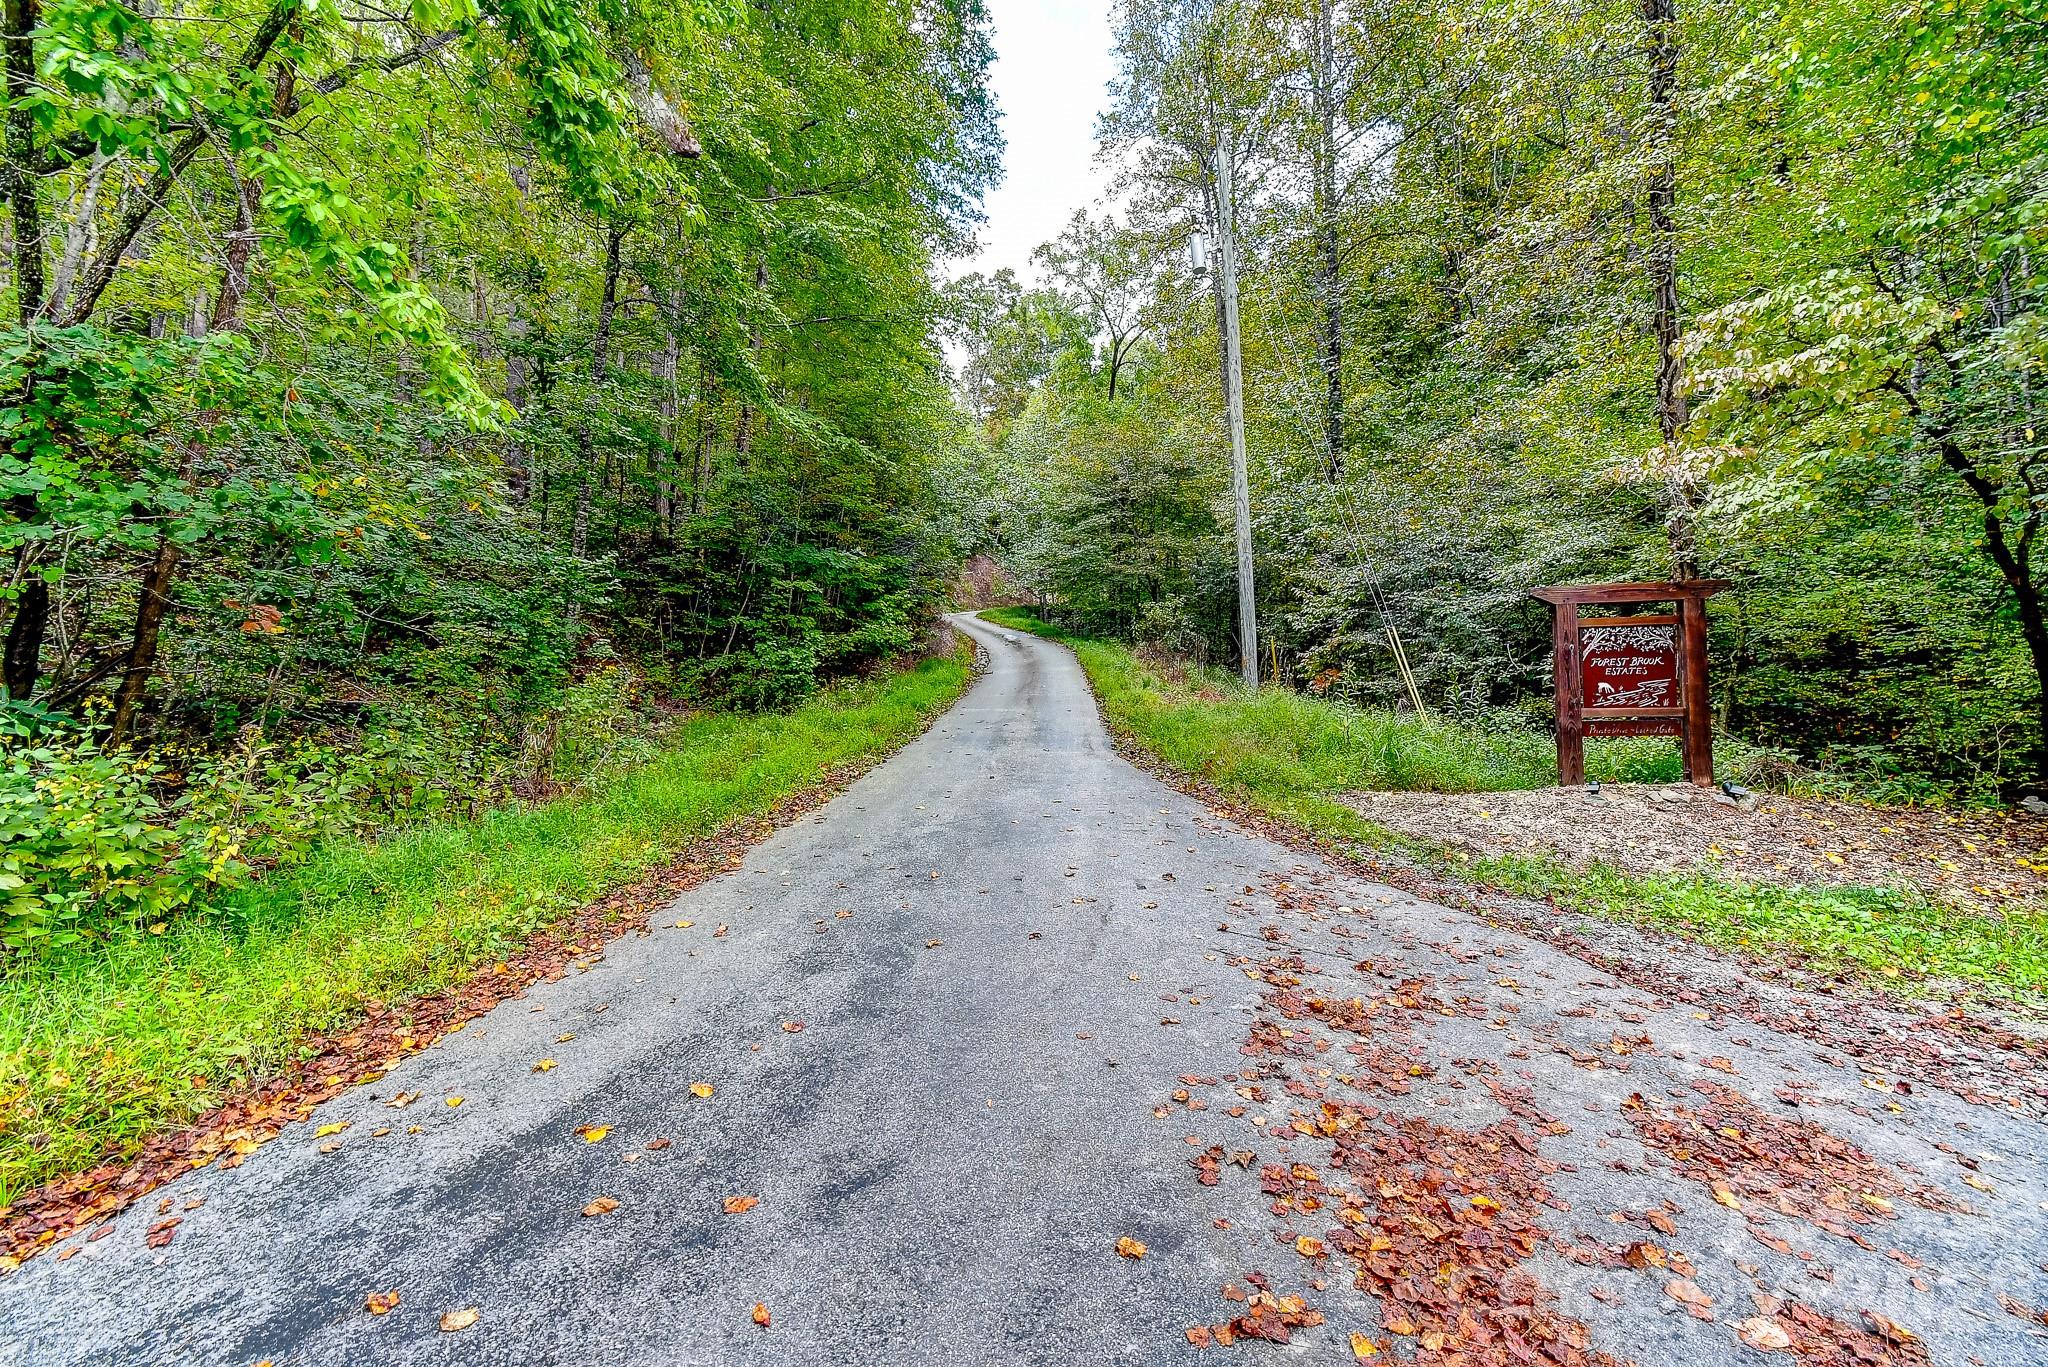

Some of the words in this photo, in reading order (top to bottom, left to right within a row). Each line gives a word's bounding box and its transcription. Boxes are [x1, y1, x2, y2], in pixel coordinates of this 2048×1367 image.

[1590, 657, 1629, 667] FOREST
[1630, 656, 1665, 666] BROOK
[1605, 667, 1648, 676] ESTATES
